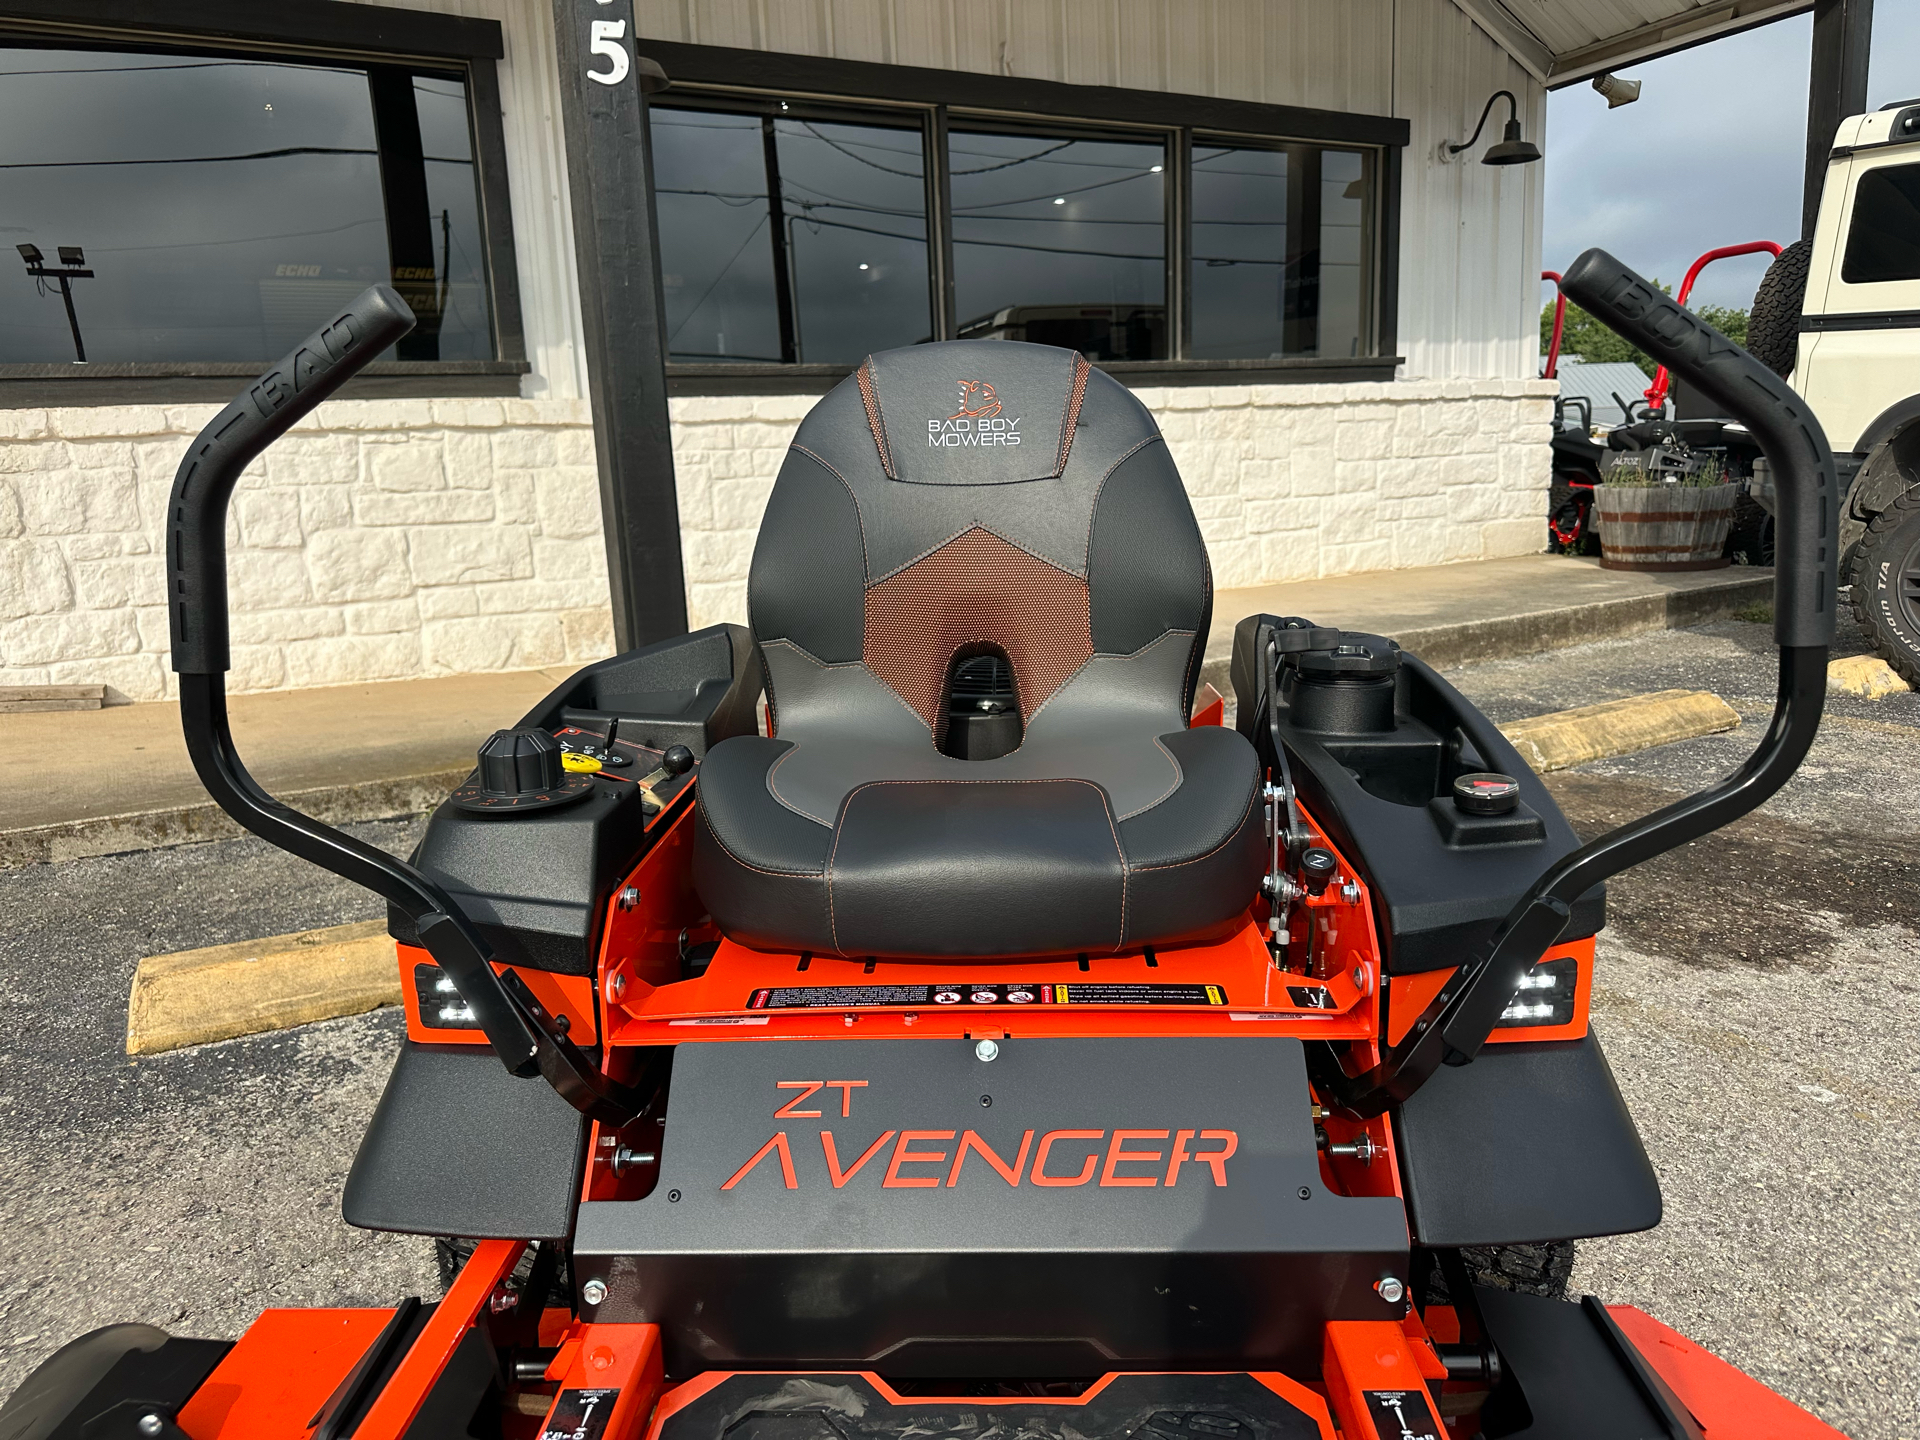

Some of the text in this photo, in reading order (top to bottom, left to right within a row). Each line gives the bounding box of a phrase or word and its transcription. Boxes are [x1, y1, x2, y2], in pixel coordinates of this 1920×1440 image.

[587, 19, 630, 85] 5
[275, 264, 321, 277] ECHO
[1599, 273, 1740, 371] BOY
[250, 312, 363, 419] BAD
[928, 417, 1020, 432] BAD BOY
[928, 432, 1021, 447] MOWERS
[1877, 561, 1891, 591] T/A
[773, 1079, 869, 1119] ZT
[719, 1128, 1239, 1191] AVENGER
